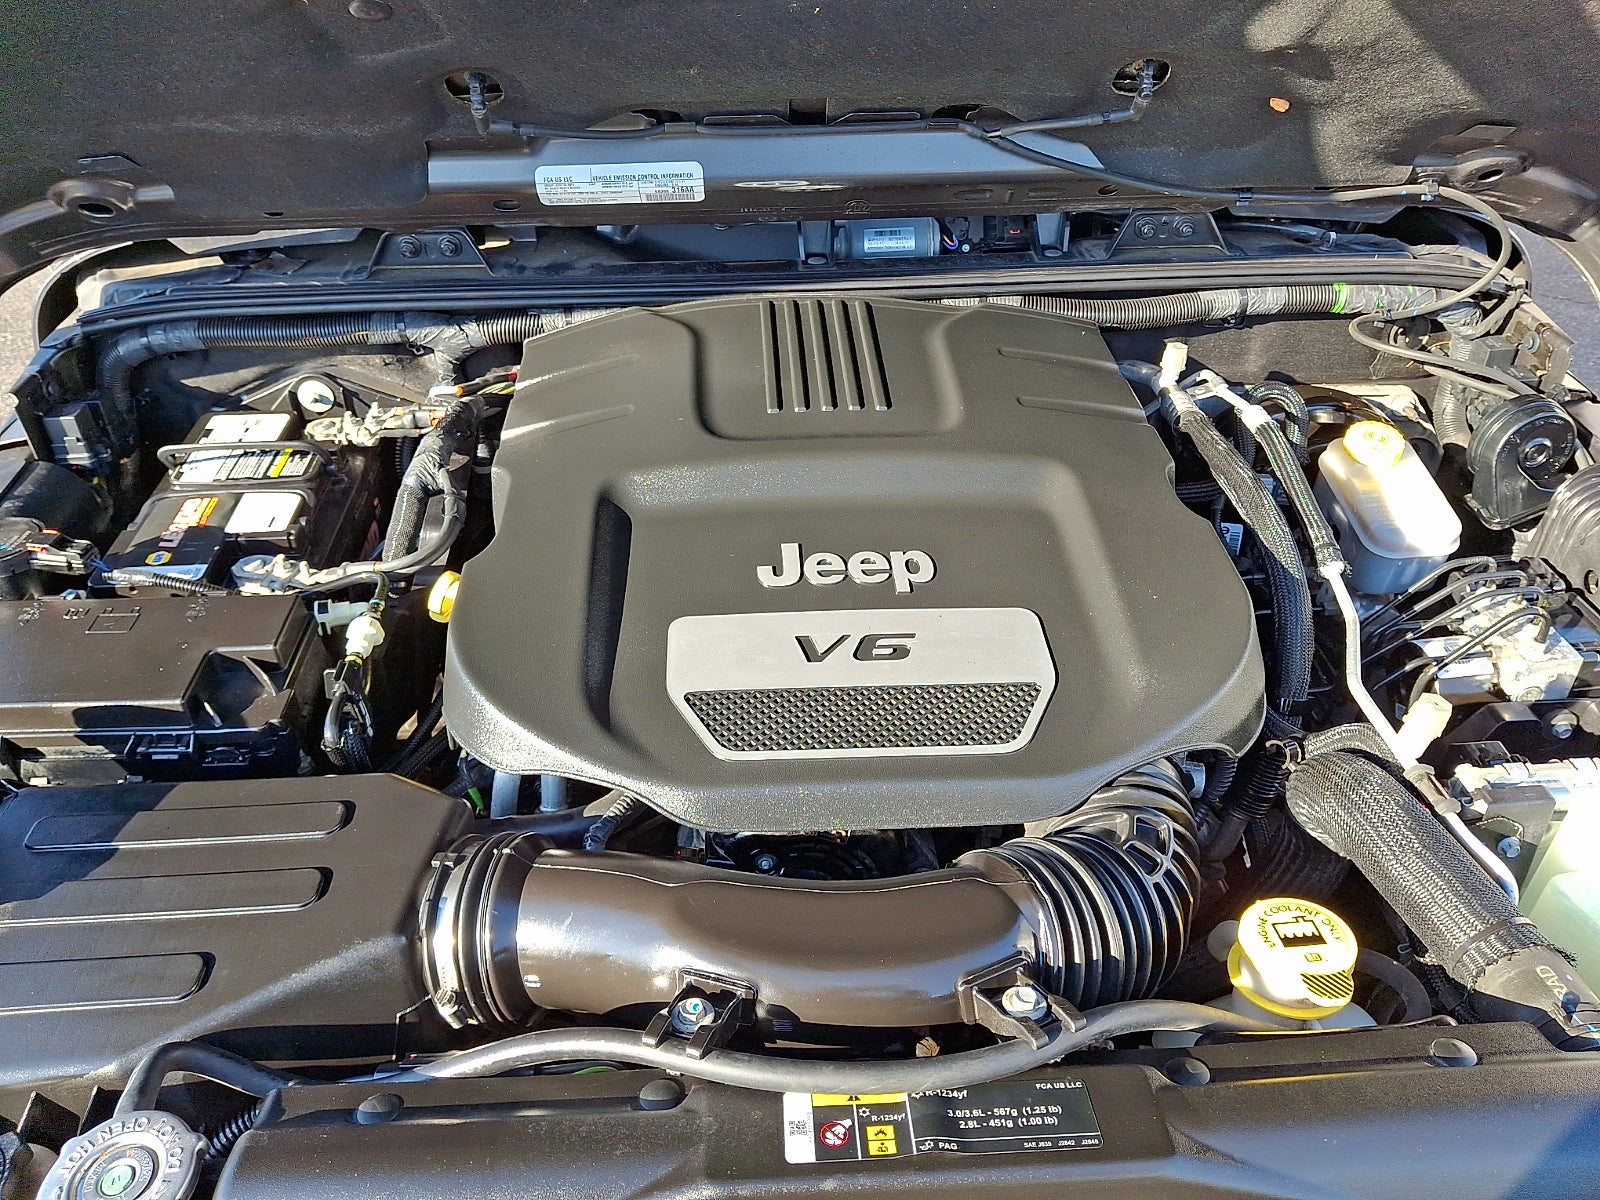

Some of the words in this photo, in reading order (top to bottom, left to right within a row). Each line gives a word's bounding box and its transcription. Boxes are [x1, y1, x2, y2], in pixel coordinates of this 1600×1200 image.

[637, 173, 660, 181] CONTROL
[660, 172, 694, 180] INFORMATION
[756, 542, 937, 595] Jeep
[794, 633, 917, 664] V6
[1263, 904, 1321, 918] COOLANT
[1256, 916, 1277, 949] ENGINE
[1321, 917, 1343, 942] ONLY
[1035, 1082, 1053, 1090] FCA
[871, 1112, 906, 1122] R-1234yf
[947, 1109, 985, 1118] 3.0/3.6L
[993, 1107, 1018, 1117] 567g
[1022, 1105, 1046, 1117] (1.25
[1048, 1105, 1063, 1115] lb)
[959, 1119, 982, 1129] 2.8L
[988, 1118, 1014, 1128] 451g
[1018, 1116, 1043, 1127] (1.00
[1044, 1115, 1059, 1126] lb)
[938, 1141, 958, 1150] PAG
